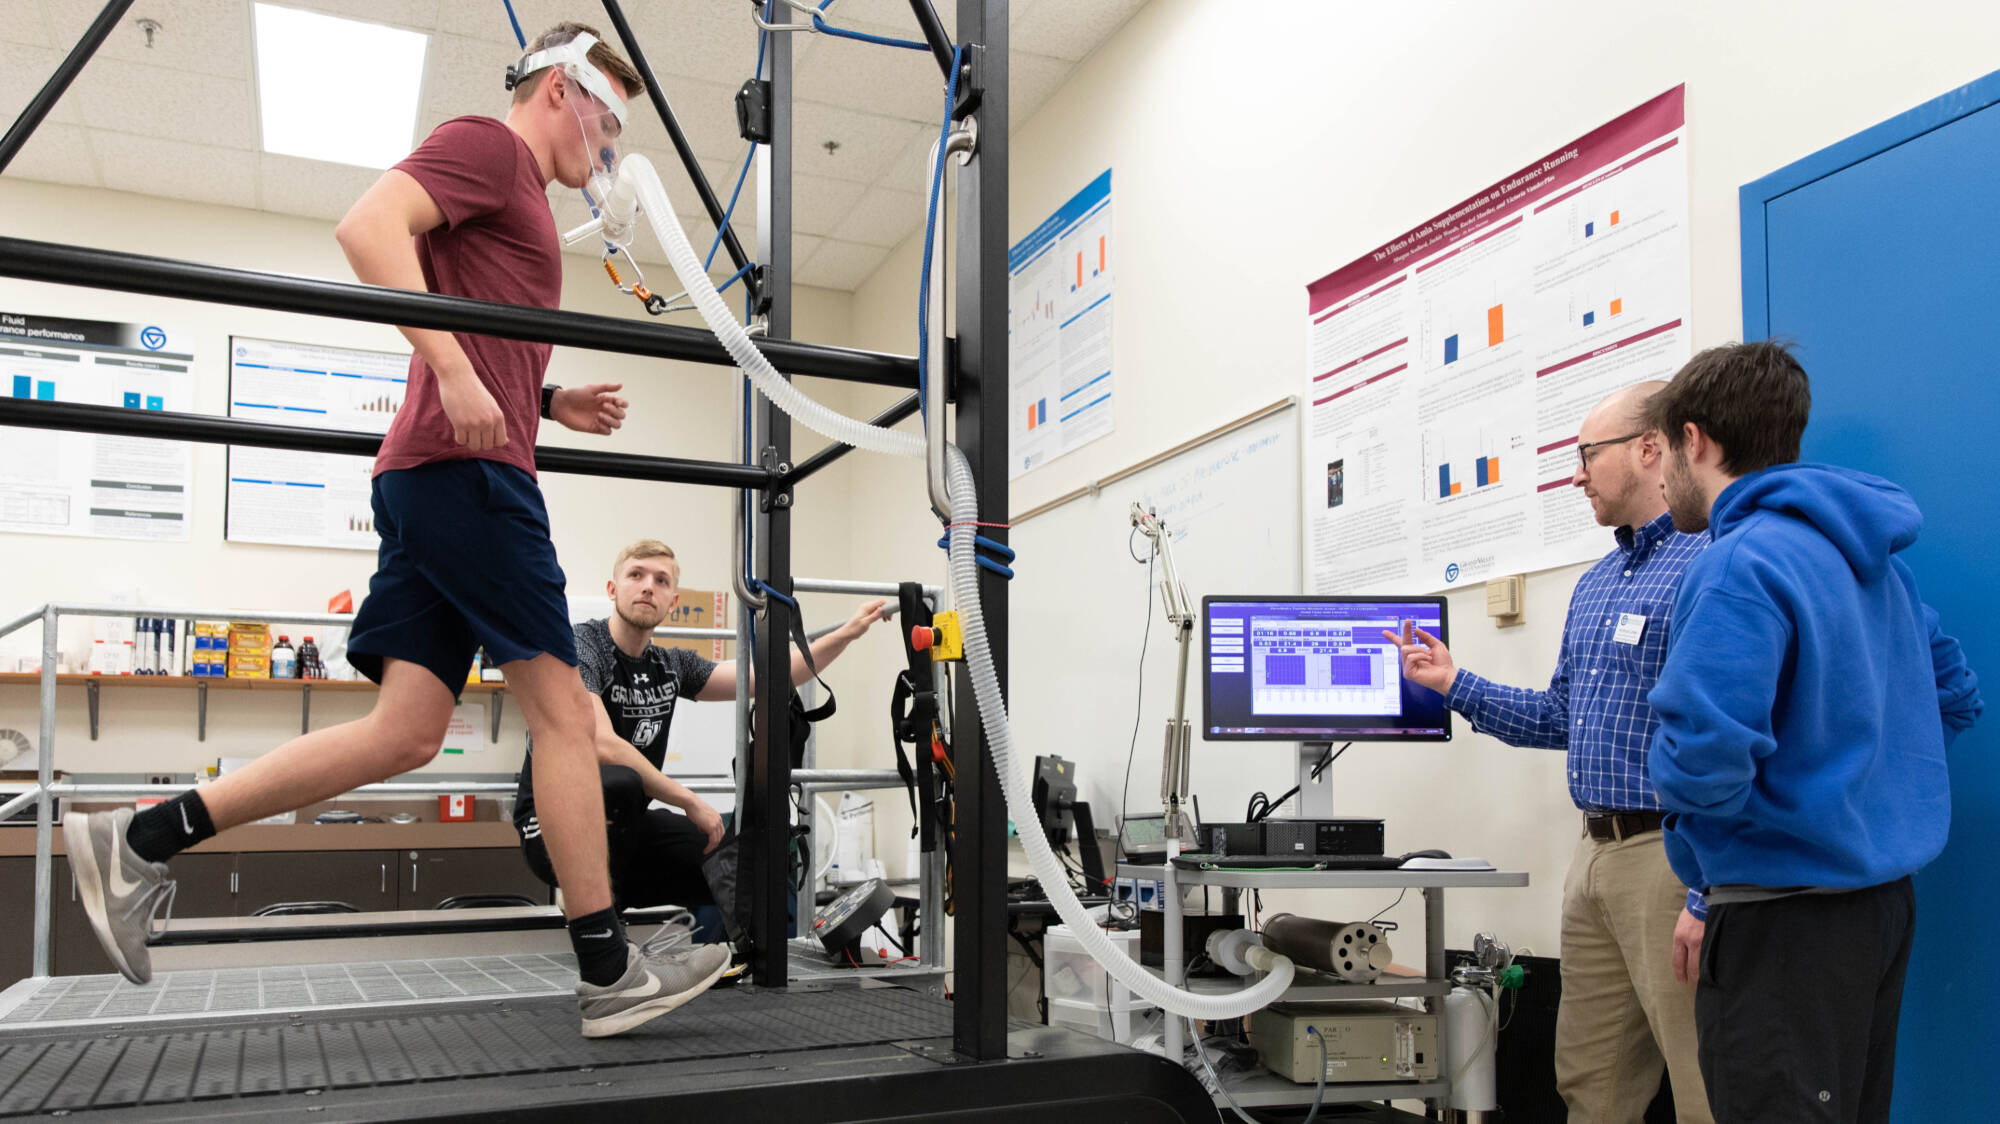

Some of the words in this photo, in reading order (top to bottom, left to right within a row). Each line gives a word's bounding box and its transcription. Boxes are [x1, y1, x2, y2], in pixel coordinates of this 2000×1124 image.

[1373, 253, 1386, 262] The
[1385, 241, 1408, 255] Effects
[1408, 234, 1415, 244] of
[1432, 196, 1490, 230] Supplementation
[1490, 190, 1501, 200] on
[1500, 168, 1543, 194] Endurance
[1542, 148, 1579, 172] Running
[2, 314, 26, 326] Fluid
[27, 328, 85, 342] performance
[611, 684, 645, 706] GRAND
